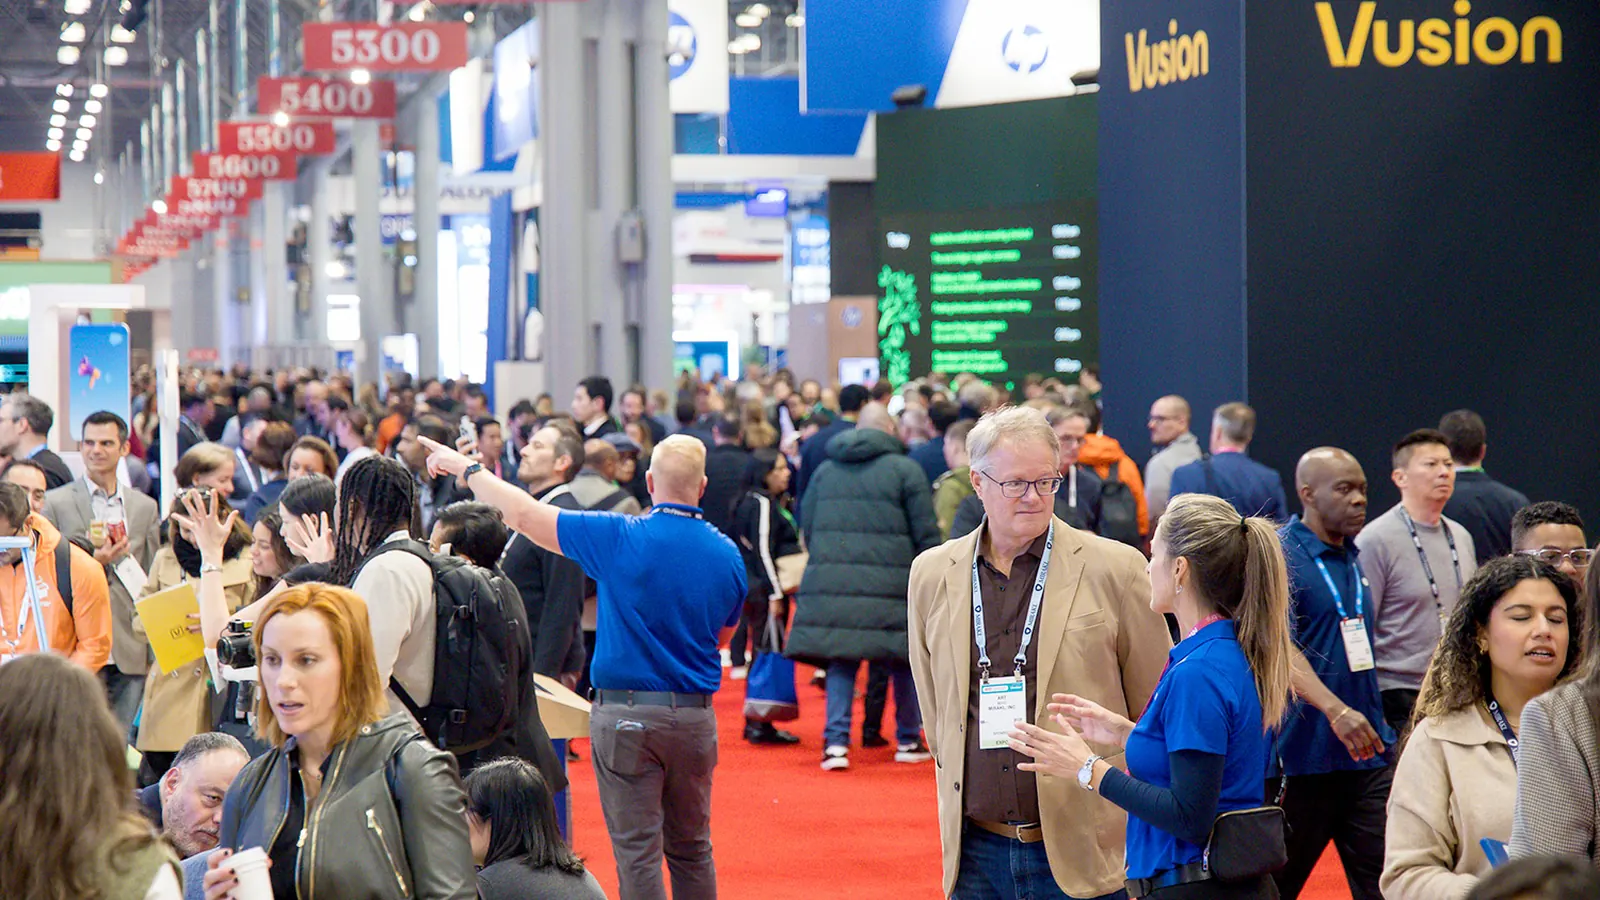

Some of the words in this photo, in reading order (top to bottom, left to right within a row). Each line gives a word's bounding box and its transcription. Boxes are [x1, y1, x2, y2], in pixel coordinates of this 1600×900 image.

[331, 29, 440, 65] 5300
[1315, 0, 1563, 68] Vusion
[1125, 18, 1210, 93] Vusion
[281, 83, 373, 114] 5400
[237, 125, 315, 152] 5500
[209, 154, 280, 178] 5600
